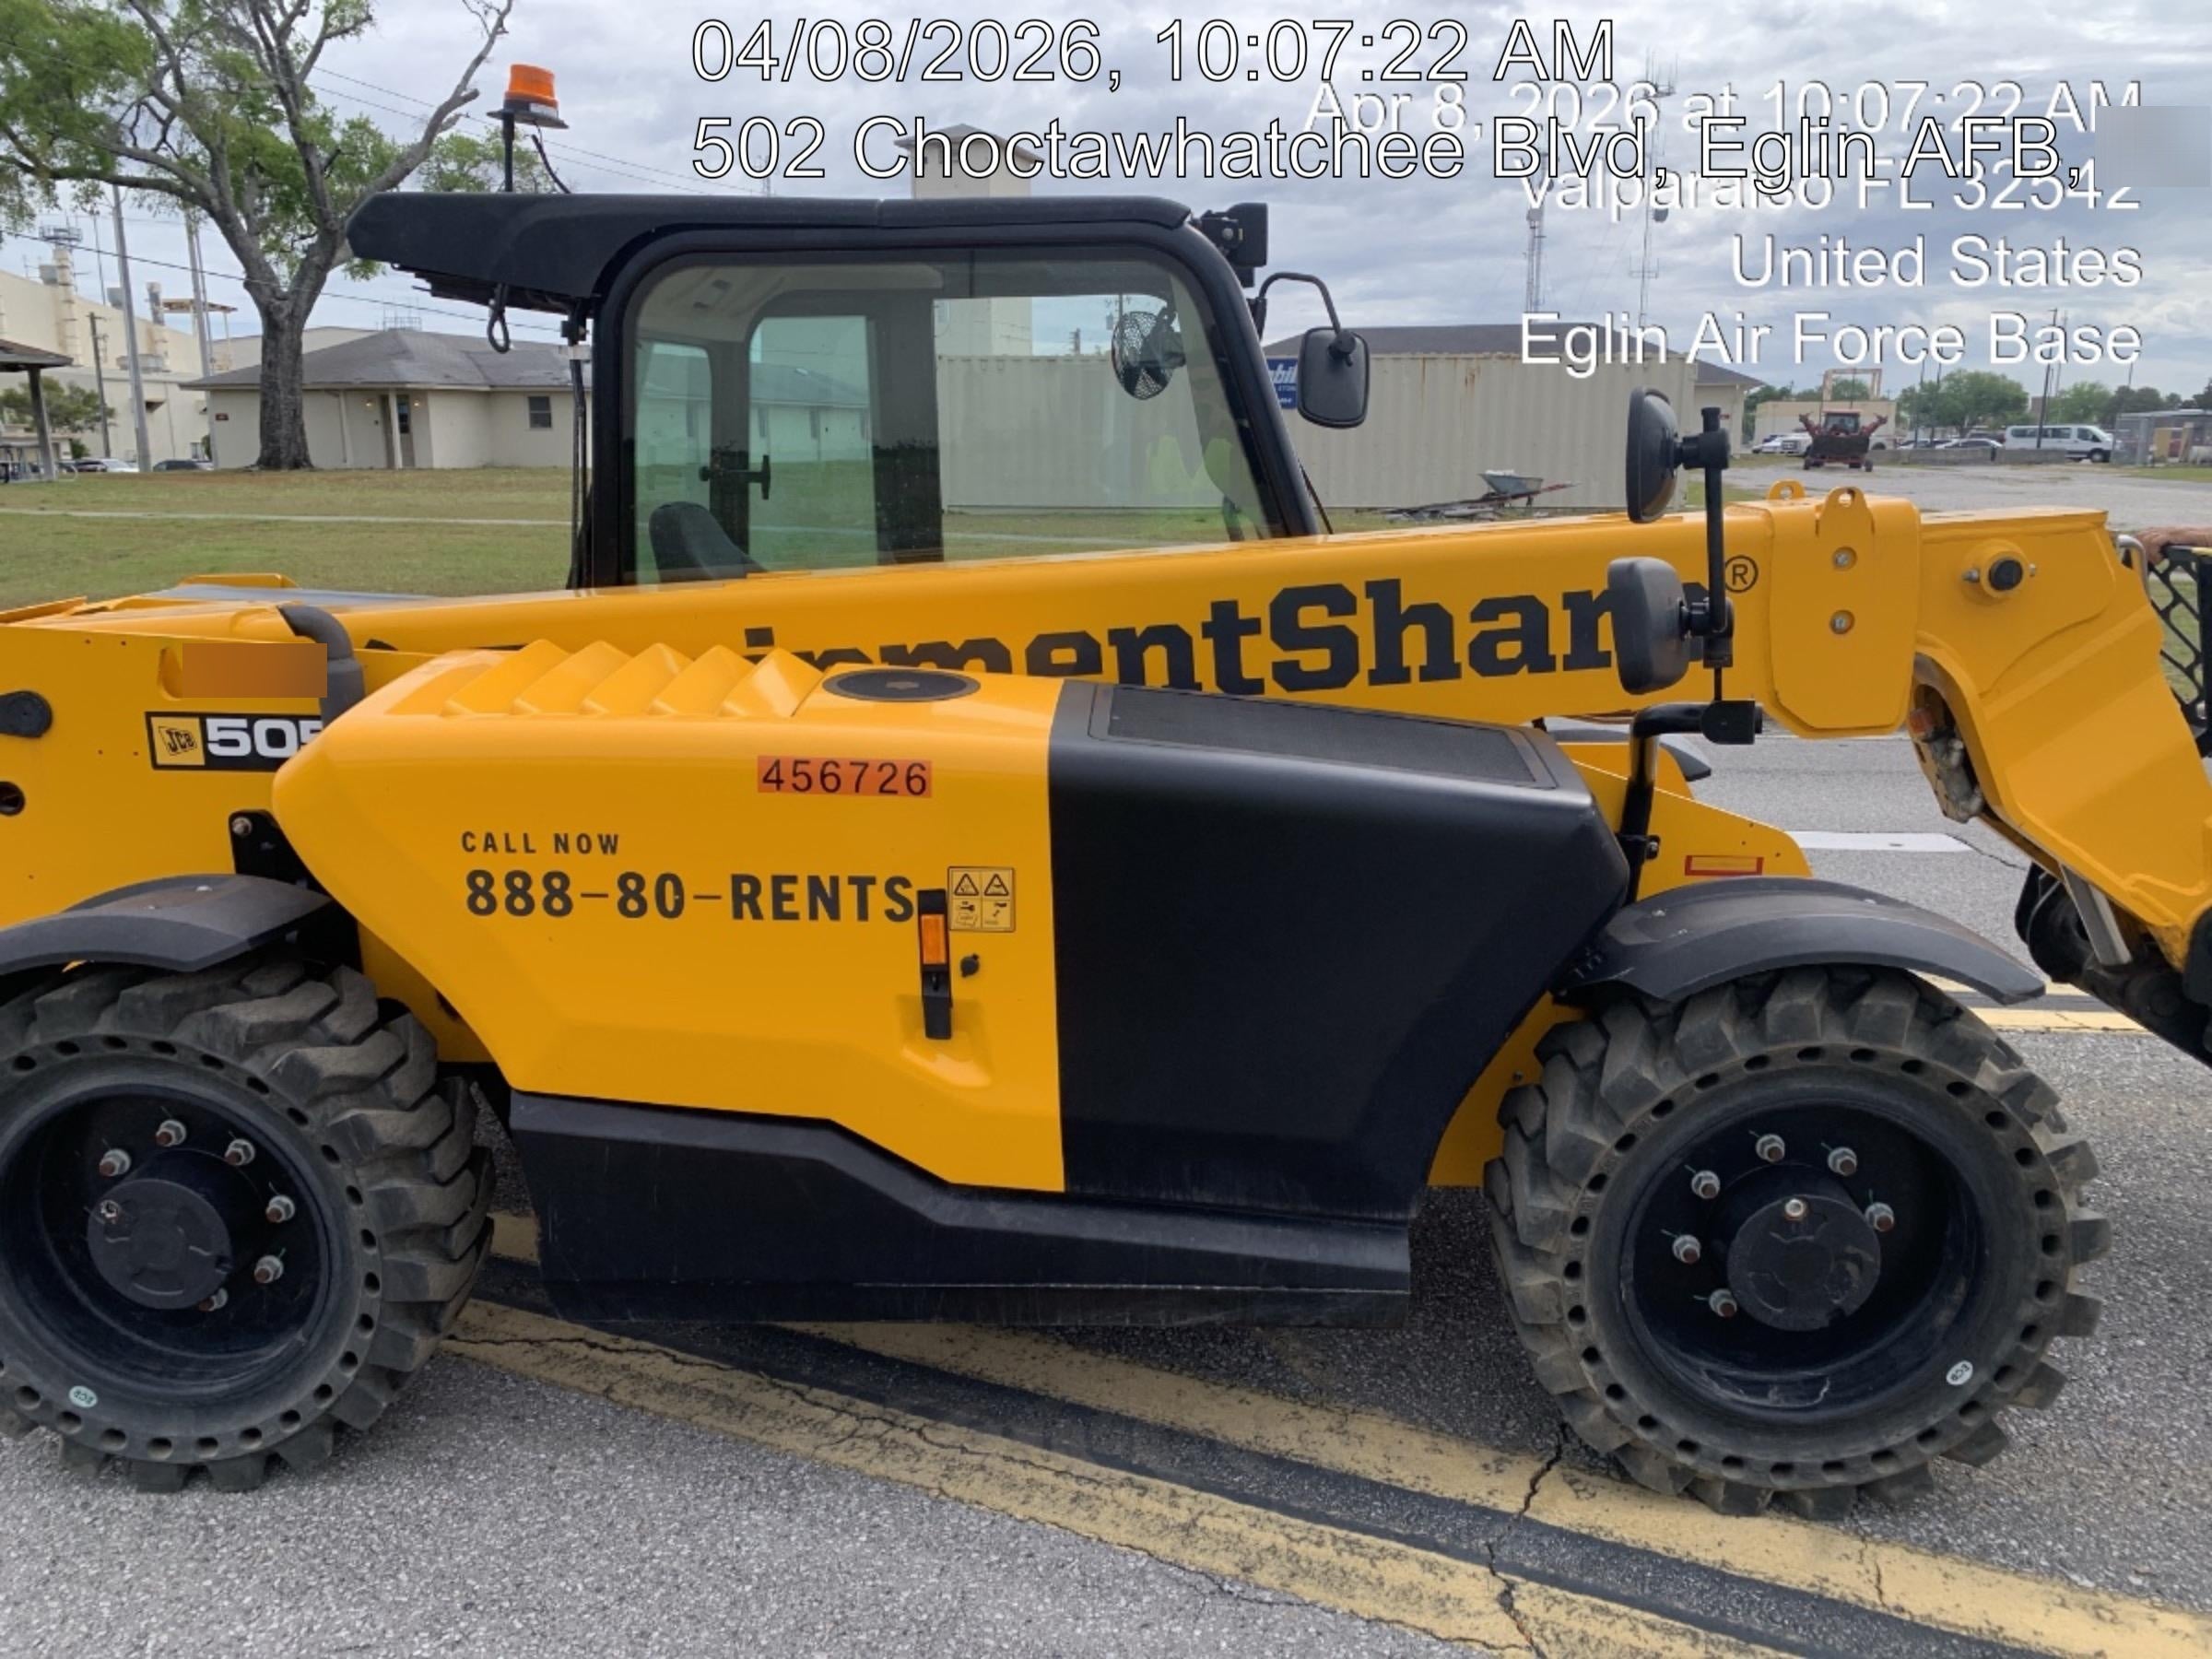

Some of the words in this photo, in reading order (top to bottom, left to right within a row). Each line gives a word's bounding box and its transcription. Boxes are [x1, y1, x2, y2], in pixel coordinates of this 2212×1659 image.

[762, 759, 927, 795] 456726
[461, 831, 536, 853] CALL
[553, 833, 620, 855] NOW
[465, 869, 914, 923] 888-80-RENTS
